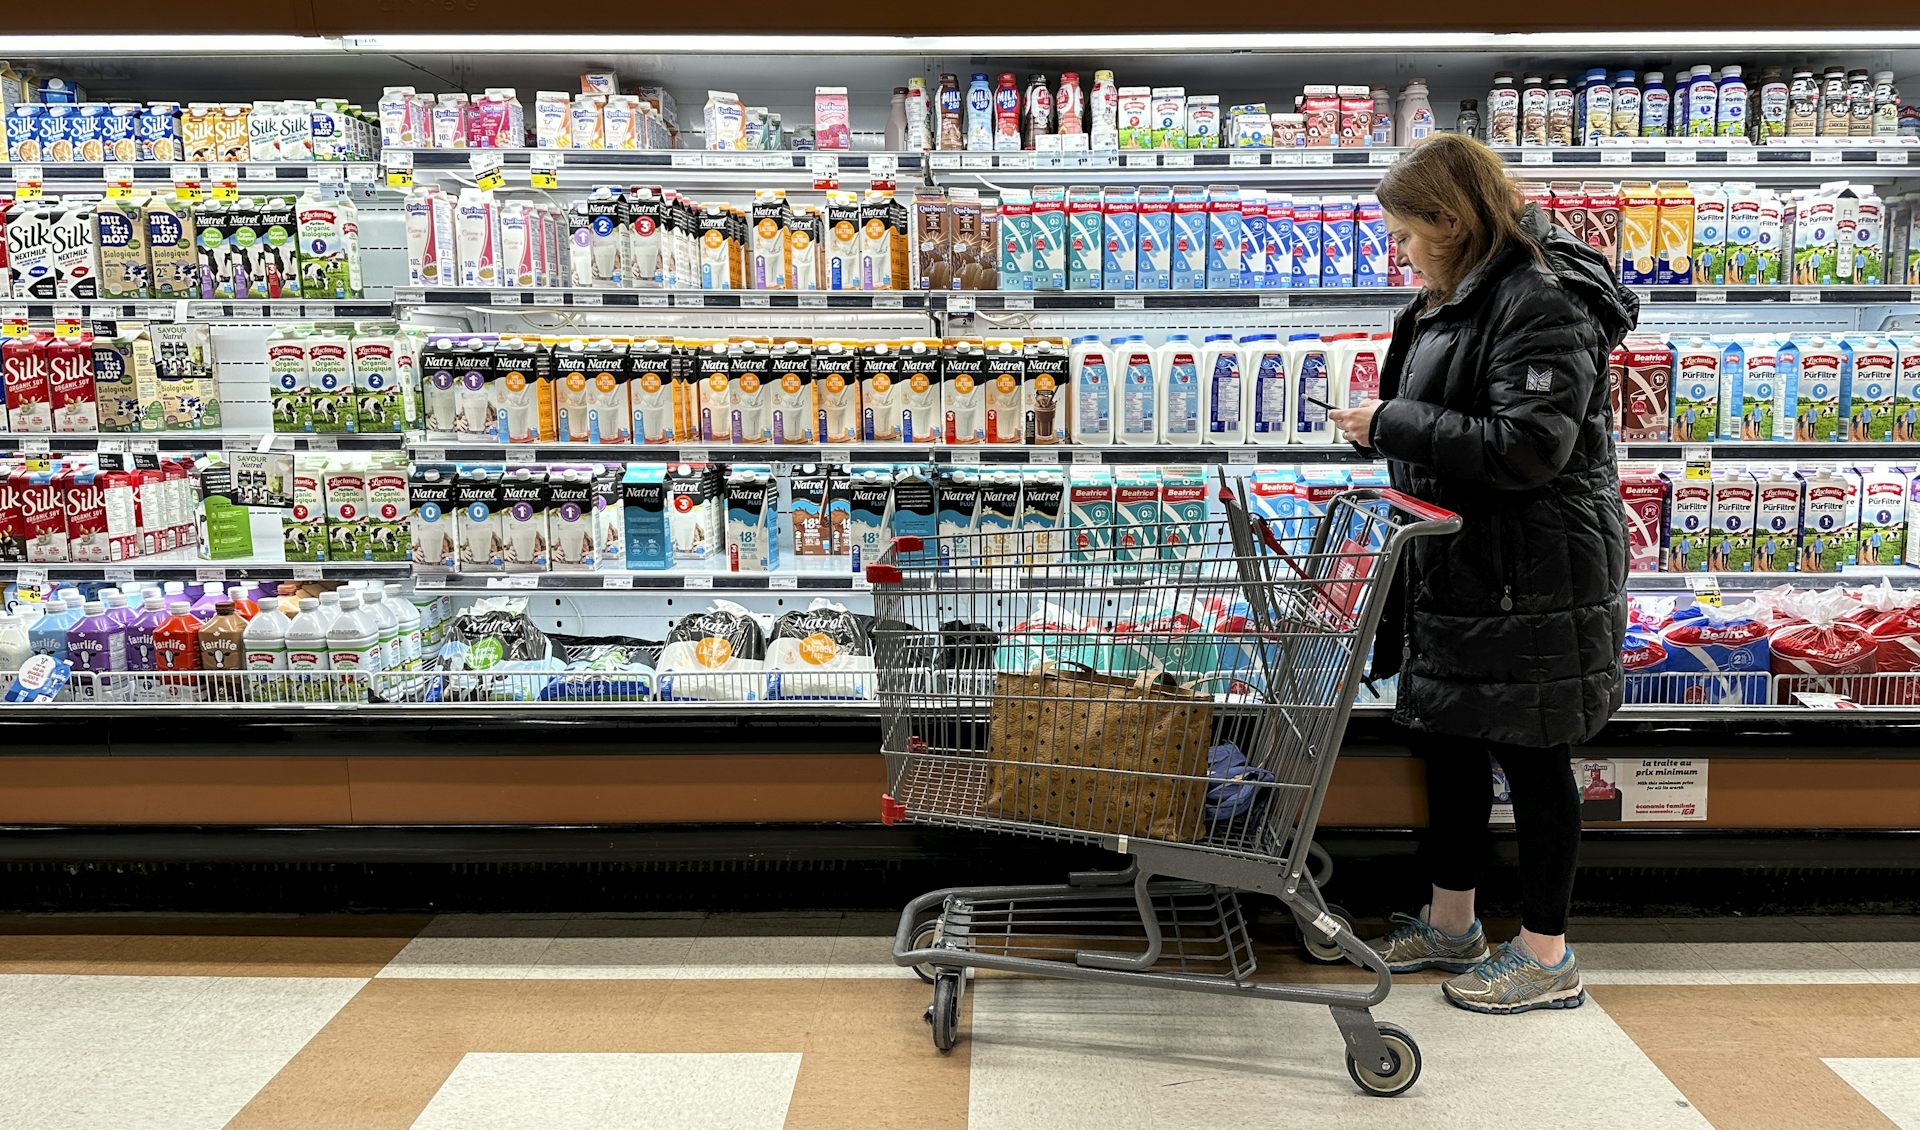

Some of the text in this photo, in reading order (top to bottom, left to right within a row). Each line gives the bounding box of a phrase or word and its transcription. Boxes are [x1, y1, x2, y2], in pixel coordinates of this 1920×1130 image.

[7, 116, 38, 137] Silk
[40, 117, 71, 137] Silk
[71, 116, 102, 137] Silk
[103, 116, 134, 137] Silk
[141, 115, 172, 136] Silk
[251, 118, 279, 137] Silk
[280, 117, 309, 136] Silk
[182, 122, 214, 143] Silk
[215, 121, 246, 143] Silk
[589, 204, 616, 213] Natrel
[630, 204, 658, 213] Natrel
[754, 207, 781, 216] Natrel
[862, 207, 889, 216] Natrel
[262, 214, 290, 223] Natrel
[831, 210, 857, 219] Natrel
[101, 215, 120, 225] nu
[151, 215, 170, 225] nu
[230, 216, 258, 224] Natrel
[700, 220, 725, 228] Natrel
[110, 225, 129, 234] tri
[160, 225, 180, 234] tri
[9, 223, 51, 253] Silk
[53, 223, 92, 253] Silk
[102, 234, 126, 243] nor
[152, 234, 177, 243] nor
[15, 248, 47, 261] NEXTMILK
[58, 248, 88, 261] NEXTMILK
[104, 251, 139, 259] Biologique
[154, 251, 189, 259] Biologique
[95, 352, 112, 361] nu
[104, 362, 120, 371] tri
[455, 357, 490, 368] Natrel
[496, 358, 532, 368] Natrel
[587, 358, 621, 369] Natrel
[633, 359, 667, 370] Natrel
[731, 359, 766, 370] Natrel
[774, 359, 807, 370] Natrel
[819, 360, 850, 370] Natrel
[865, 360, 897, 370] Natrel
[902, 360, 936, 370] Natrel
[947, 360, 981, 371] Natrel
[989, 360, 1023, 371] Natrel
[1027, 360, 1062, 370] Natrel
[5, 355, 47, 385] Silk
[50, 354, 93, 385] Silk
[97, 370, 120, 380] nor
[98, 386, 132, 394] Biologique
[793, 480, 824, 490] Natrel
[1261, 483, 1294, 492] Beatrice
[412, 488, 448, 499] Natrel
[459, 488, 495, 498] Natrel
[504, 488, 538, 498] Natrel
[552, 488, 587, 499] Natrel
[626, 487, 659, 498] Natrel
[730, 489, 763, 499] Natrel
[853, 490, 887, 500] Natrel
[942, 491, 975, 501] Natrel
[983, 491, 1016, 501] Natrel
[1027, 491, 1060, 501] Natrel
[1075, 489, 1108, 497] Beatrice
[1122, 489, 1155, 497] Beatrice
[1168, 489, 1201, 497] Beatrice
[22, 486, 66, 516] Silk
[66, 486, 105, 516] Silk
[68, 639, 103, 651] fairlife
[154, 639, 186, 650] fairlife
[202, 639, 238, 651] fairlife
[1636, 769, 1653, 777] prix
